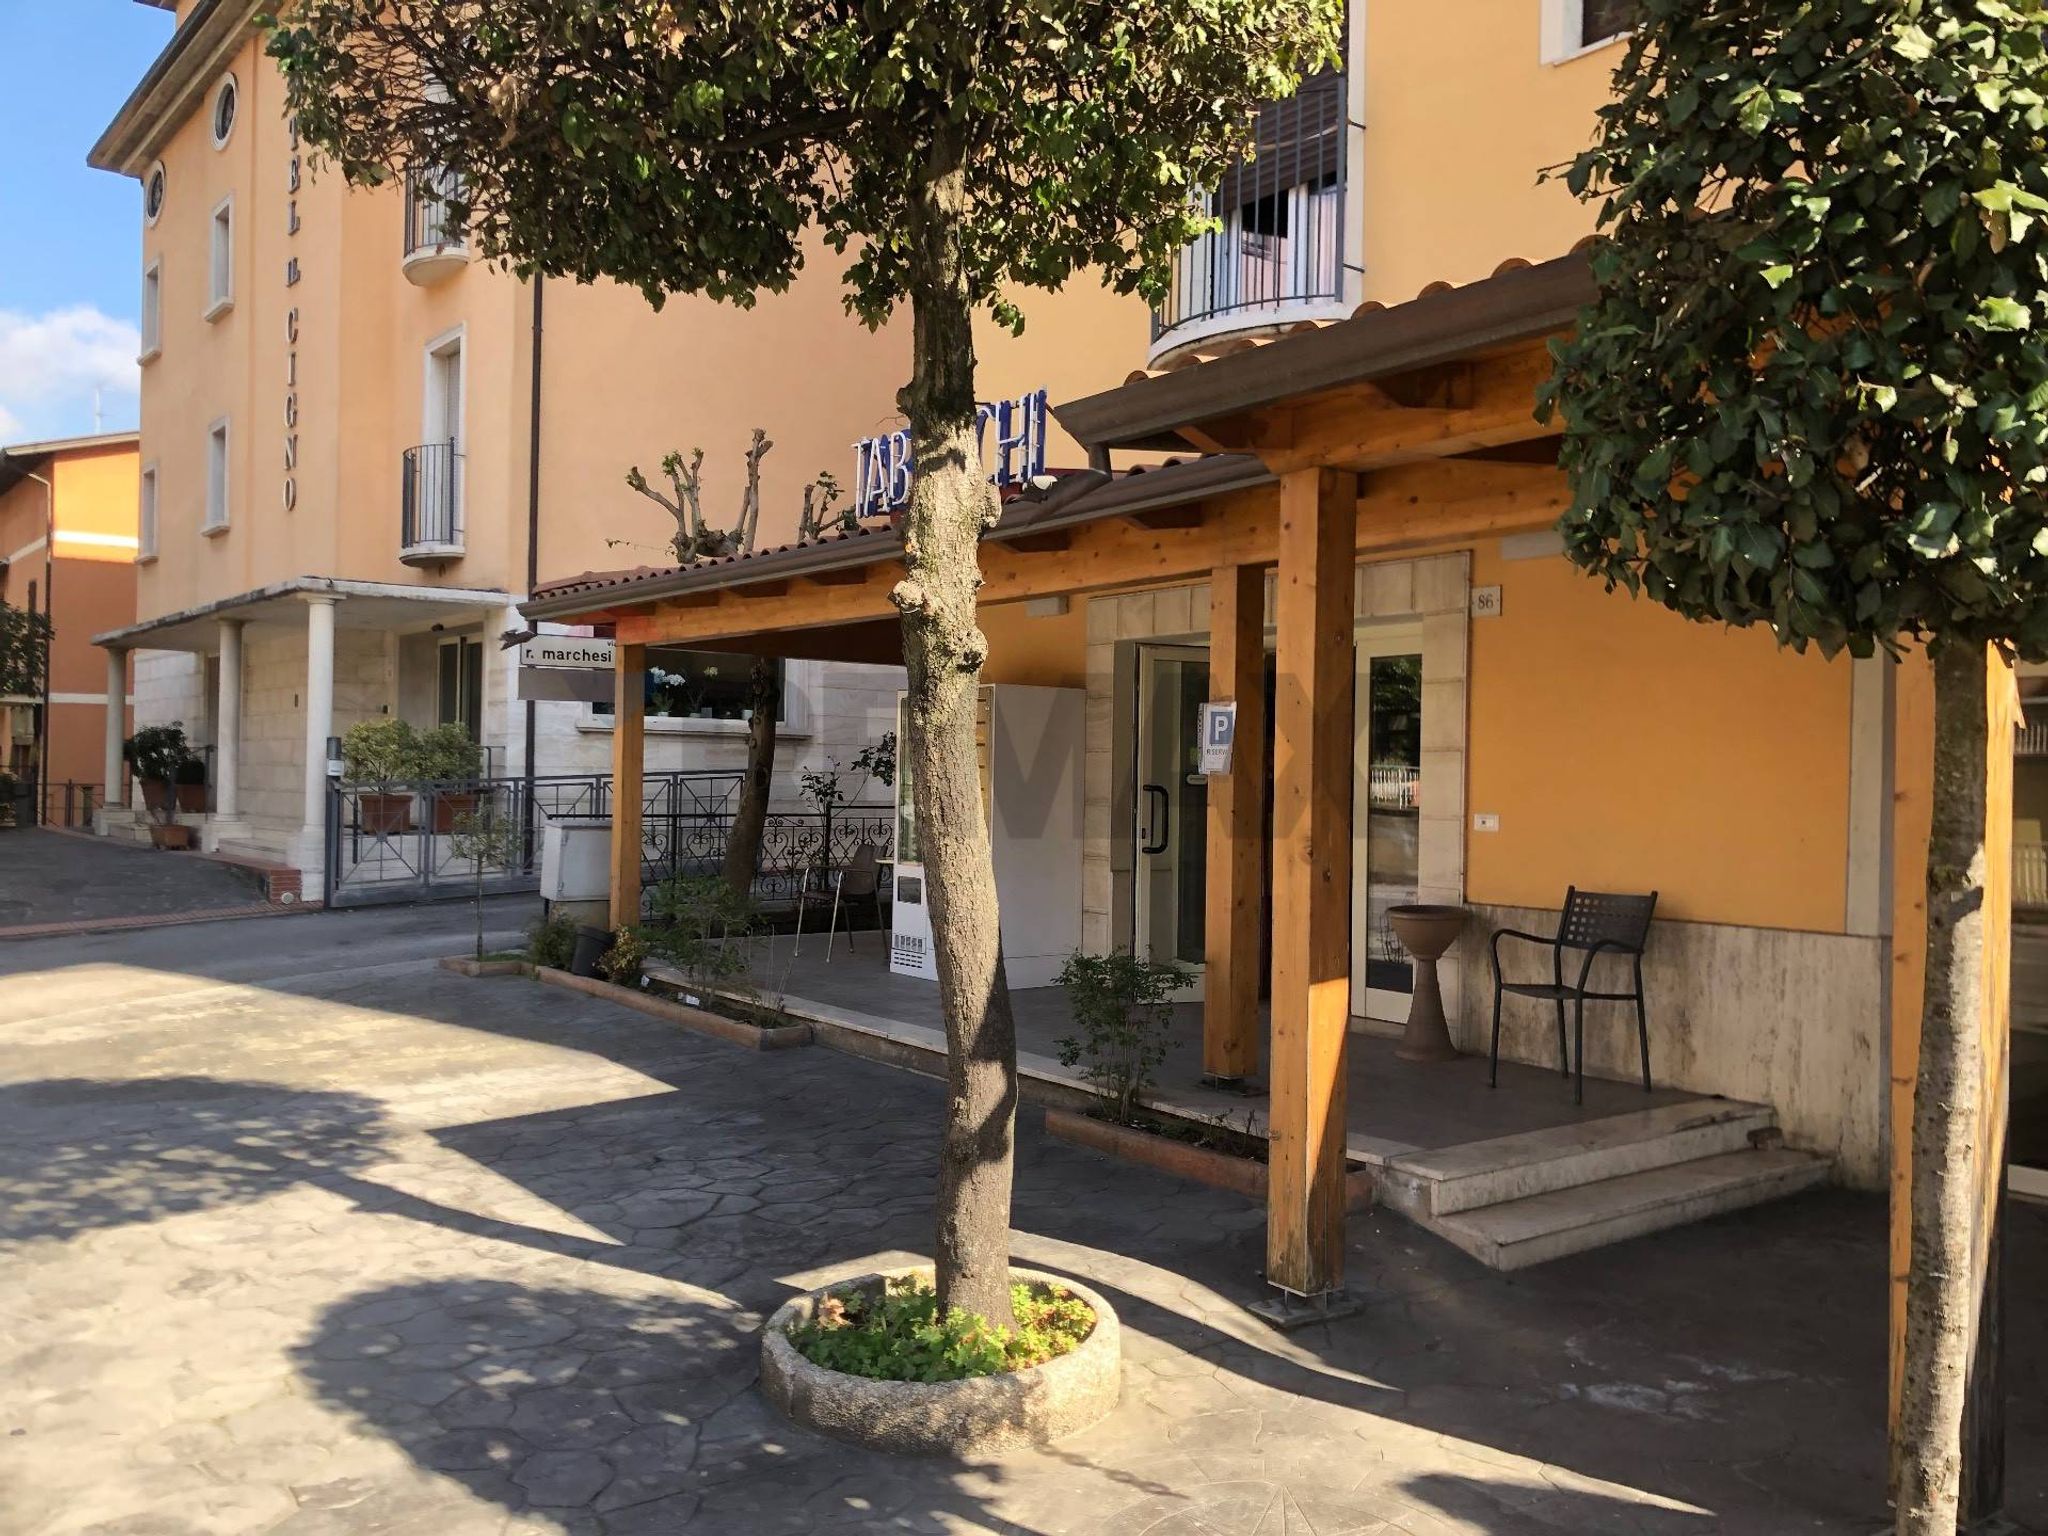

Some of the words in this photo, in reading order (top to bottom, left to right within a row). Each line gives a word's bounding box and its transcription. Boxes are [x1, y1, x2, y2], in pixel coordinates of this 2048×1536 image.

[283, 306, 299, 512] CIGNO
[851, 387, 1047, 518] TABHI
[1478, 593, 1494, 610] 86
[526, 649, 534, 659] r.
[542, 648, 612, 663] marchesi
[1215, 715, 1229, 741] P
